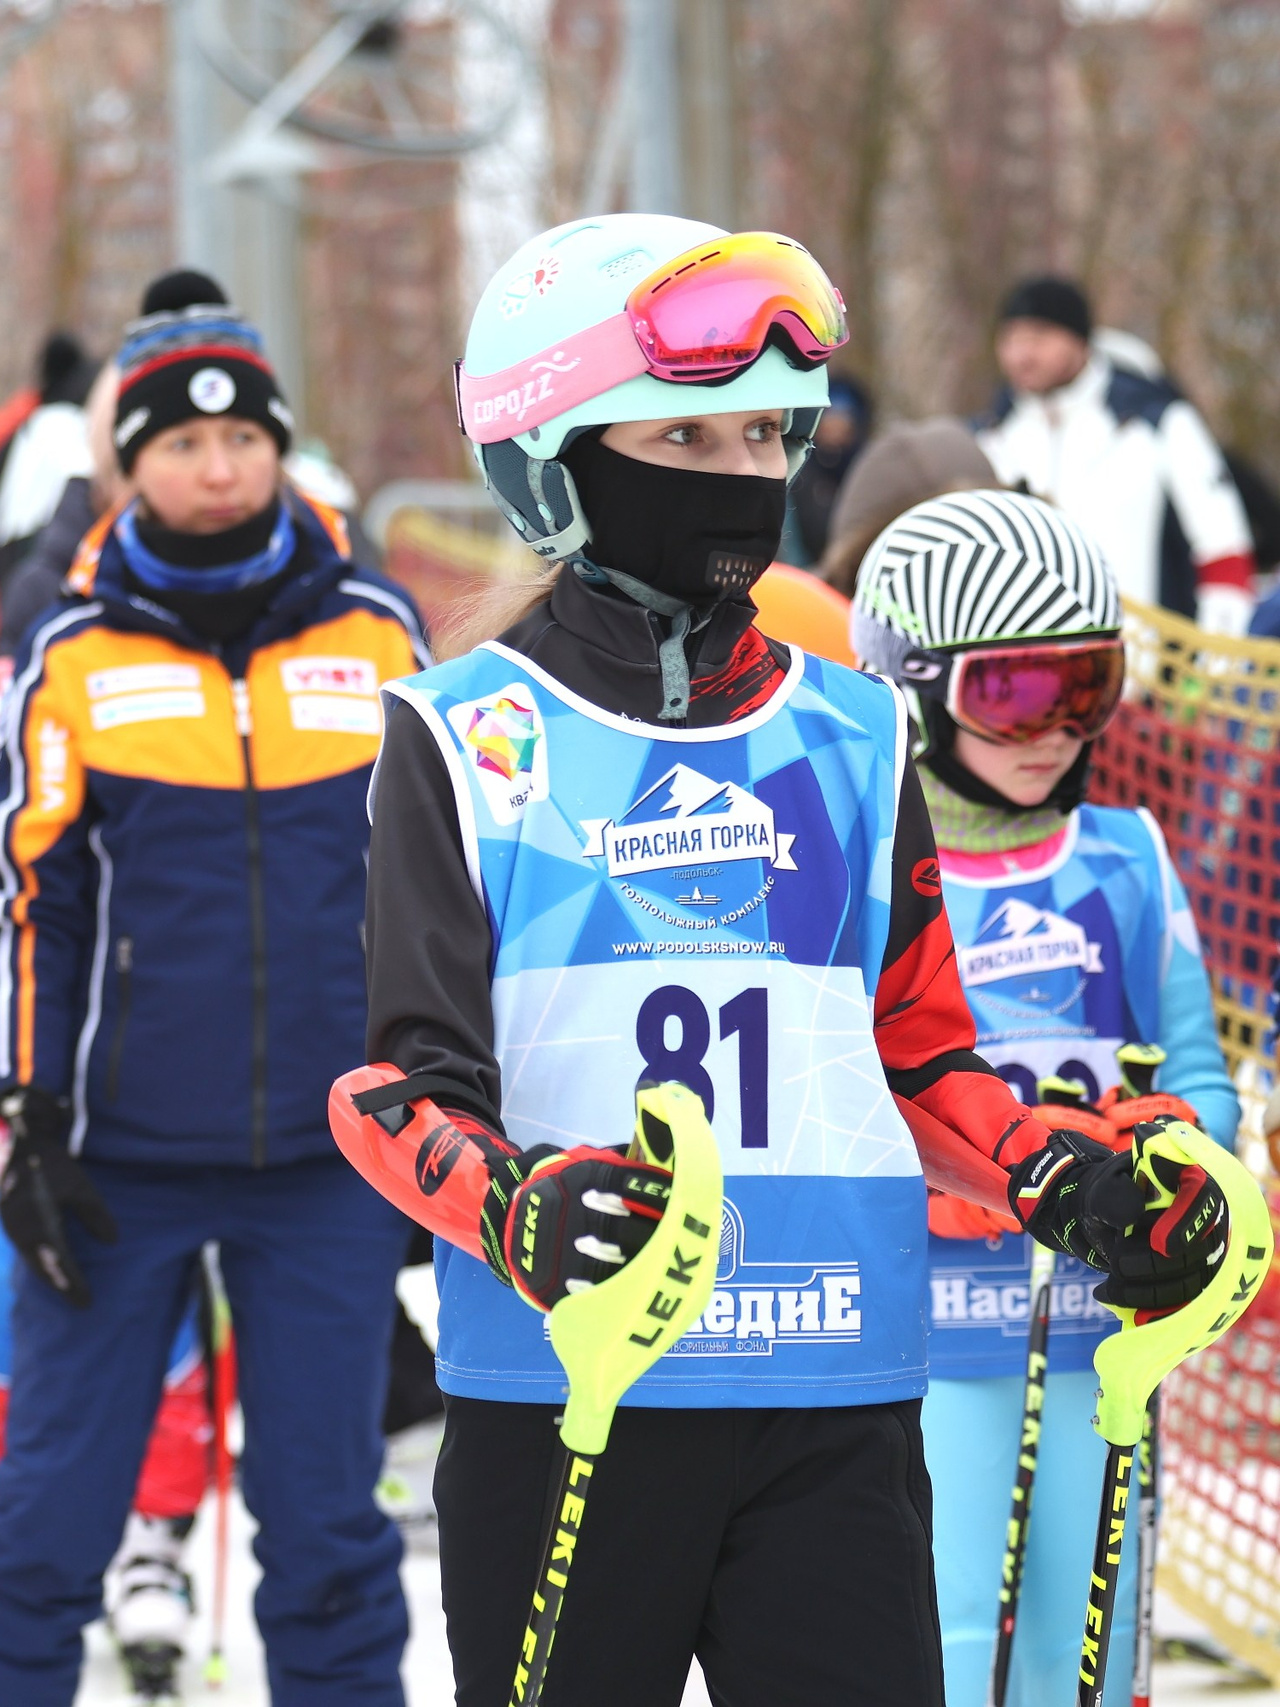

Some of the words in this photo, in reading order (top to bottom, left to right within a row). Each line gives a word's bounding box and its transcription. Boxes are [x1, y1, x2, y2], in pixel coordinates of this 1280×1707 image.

[473, 371, 555, 424] COPOZZ
[614, 828, 702, 863] КРАСНАЯ
[710, 823, 769, 850] ГОРКА
[619, 882, 718, 930] ГОРНОЛЫЖНЫЙ
[720, 875, 776, 926] КОМПЛЕКС
[612, 941, 786, 955] WWW.PODOLSKSNOW.RU
[635, 984, 768, 1148] 81
[627, 1177, 672, 1199] LE
[521, 1191, 541, 1273] LEKI
[1185, 1196, 1216, 1242] LEKI
[628, 1213, 711, 1347] LEKI
[736, 1340, 766, 1352] ФОНД
[546, 1456, 594, 1588] LEKI
[1106, 1454, 1133, 1565] LEKI
[1078, 1569, 1107, 1687] LEKI
